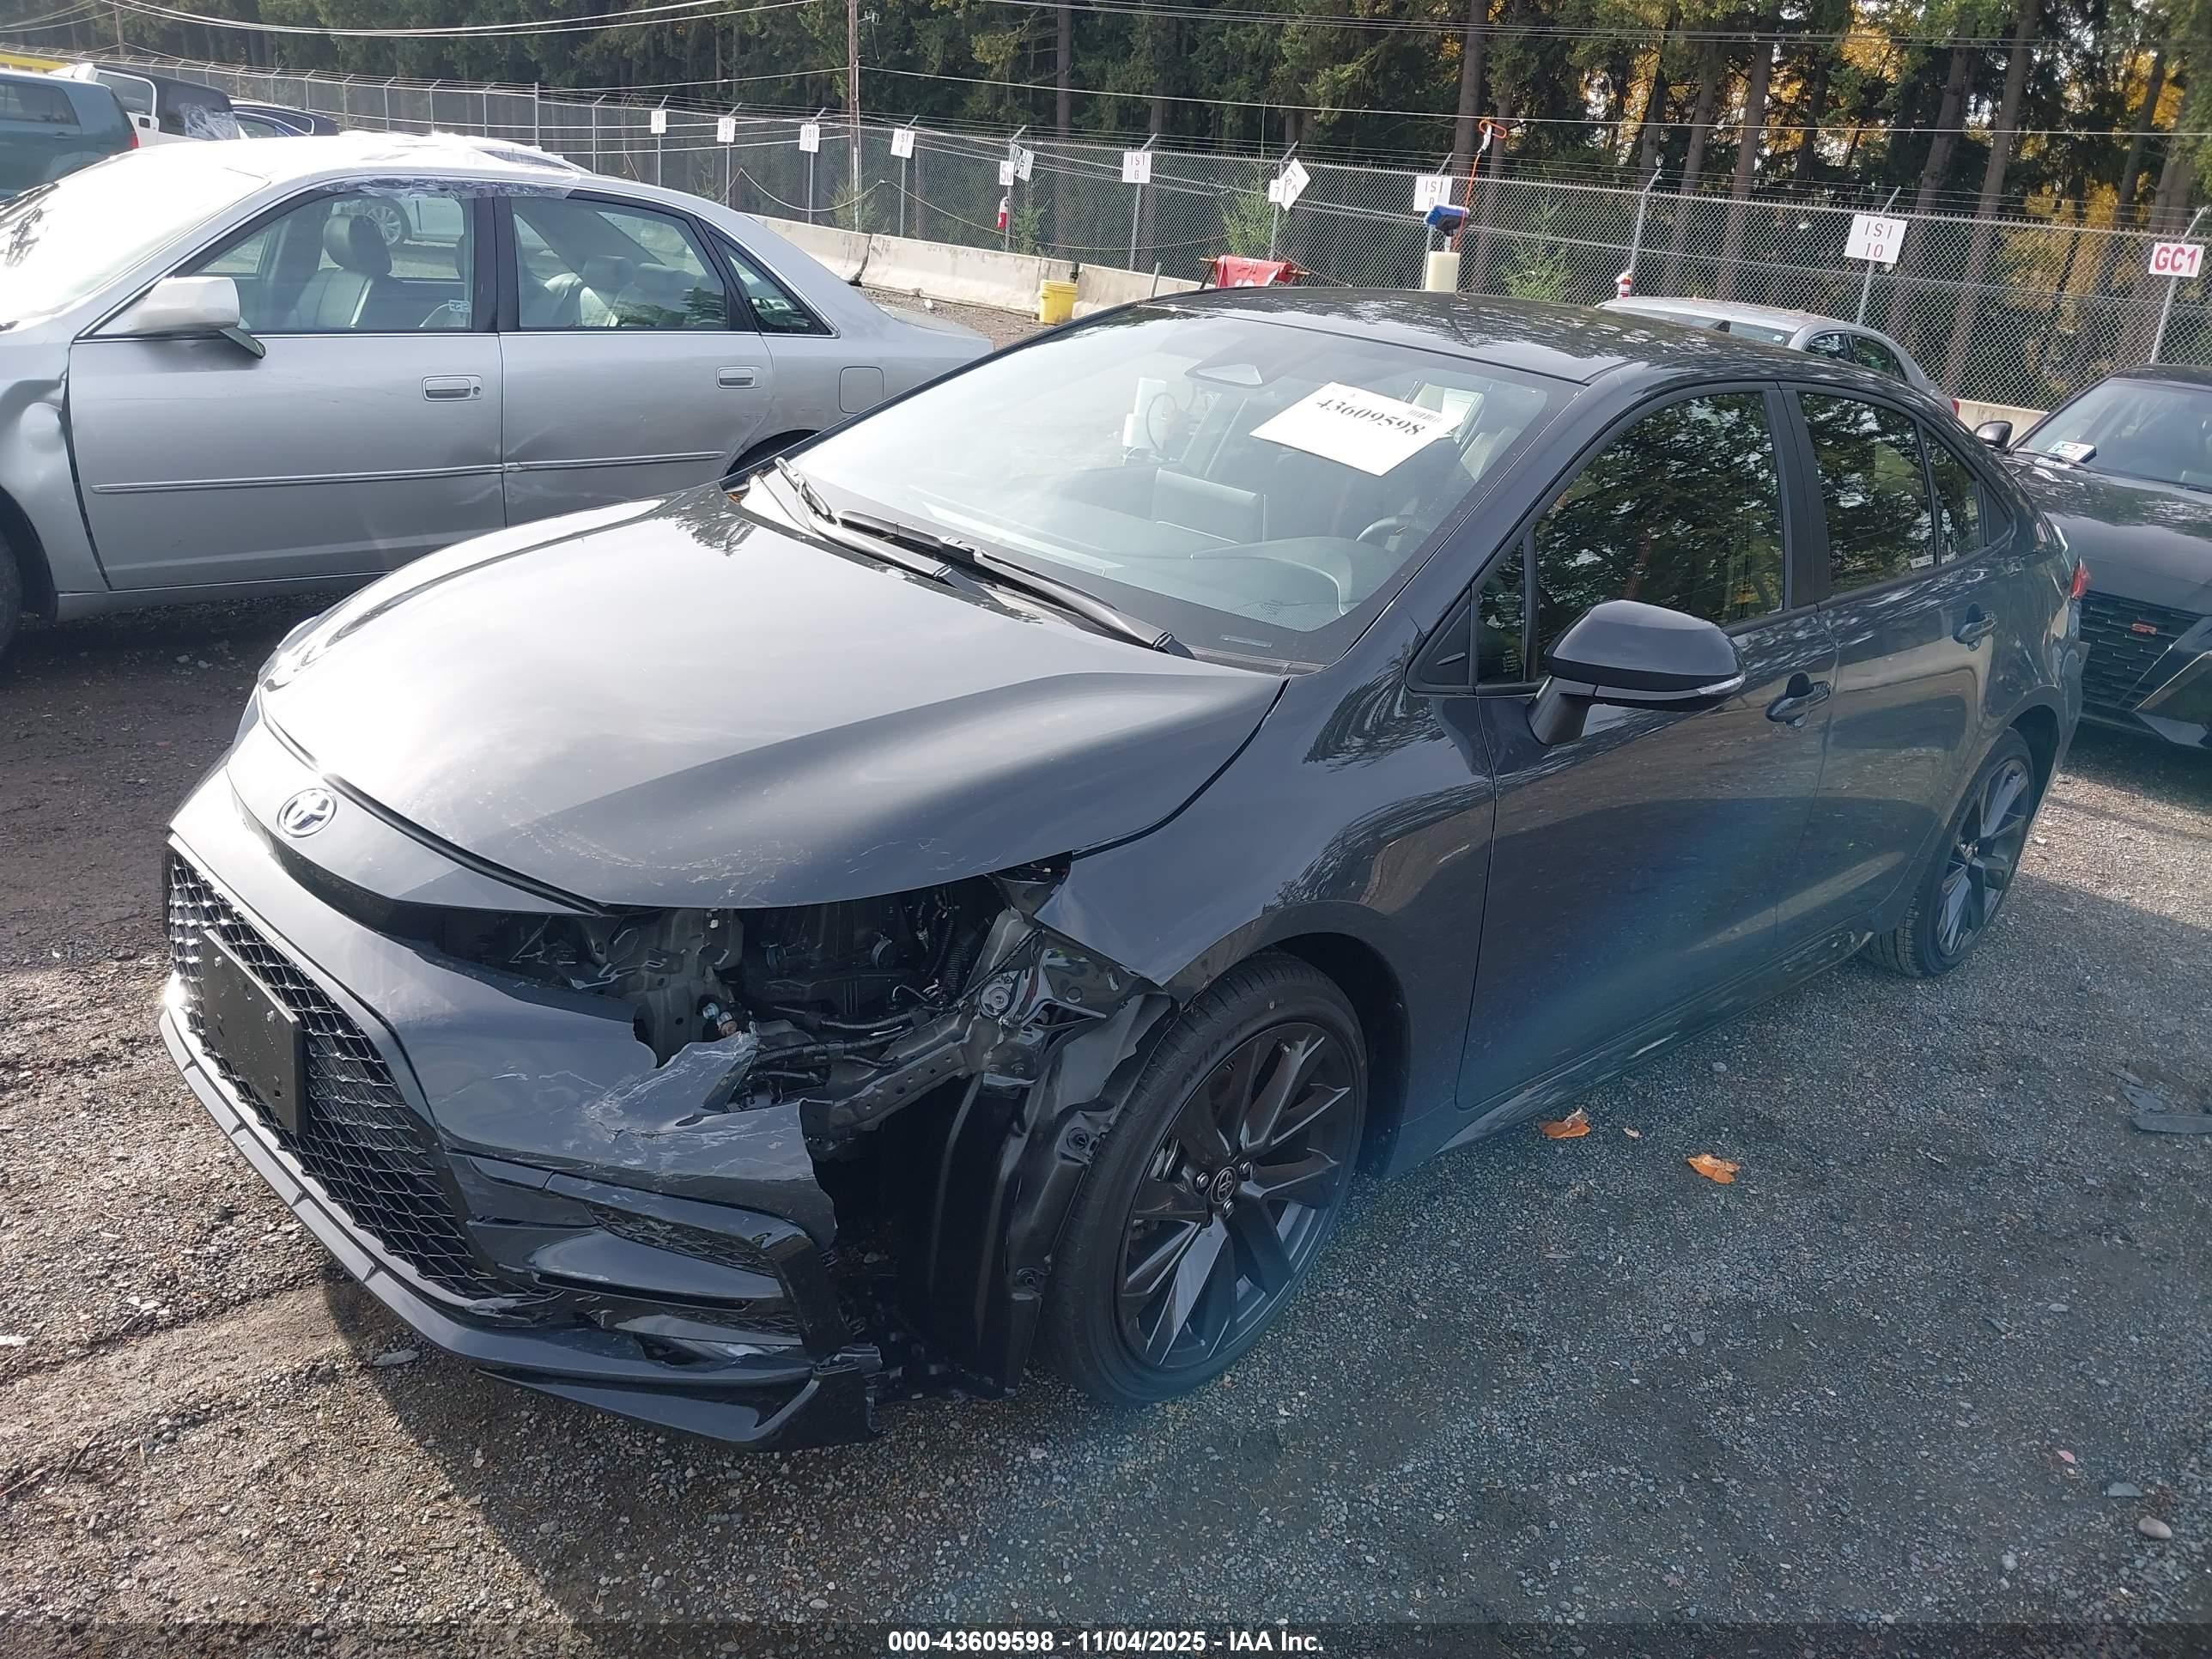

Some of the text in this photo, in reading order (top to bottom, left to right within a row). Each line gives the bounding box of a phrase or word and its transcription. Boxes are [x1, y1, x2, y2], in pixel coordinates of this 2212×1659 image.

[1865, 242, 1884, 258] 10
[2154, 246, 2198, 274] GC1
[1316, 398, 1426, 436] 43609598
